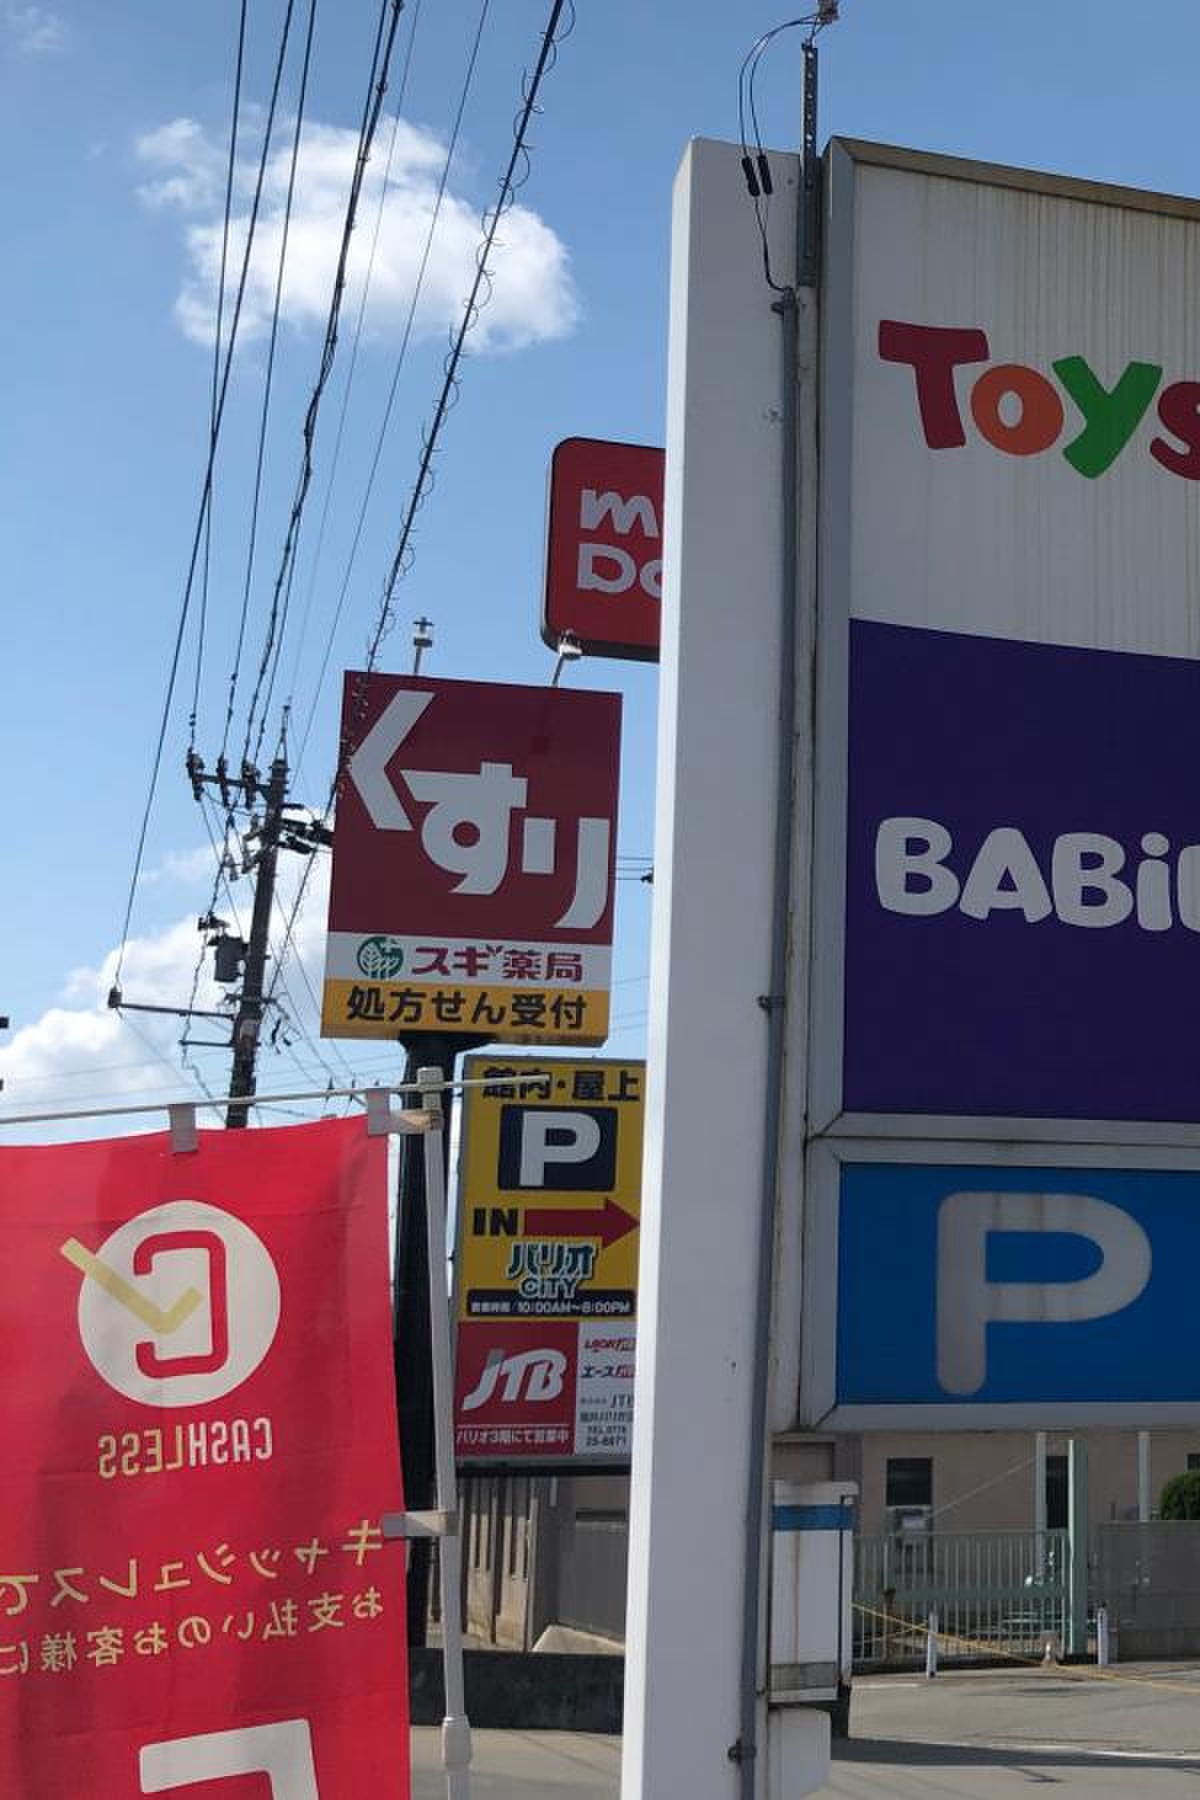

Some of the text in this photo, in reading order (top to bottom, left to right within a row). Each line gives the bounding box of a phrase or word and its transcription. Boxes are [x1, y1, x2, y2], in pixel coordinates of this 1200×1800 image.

[349, 689, 610, 929] くすり
[411, 945, 583, 982] スギ薬局
[346, 985, 587, 1030] 処方せん受付
[519, 1111, 600, 1187] P
[473, 1208, 519, 1237] IN
[519, 1277, 578, 1298] CITY
[936, 1192, 1153, 1395] P
[463, 1348, 567, 1411] JTB
